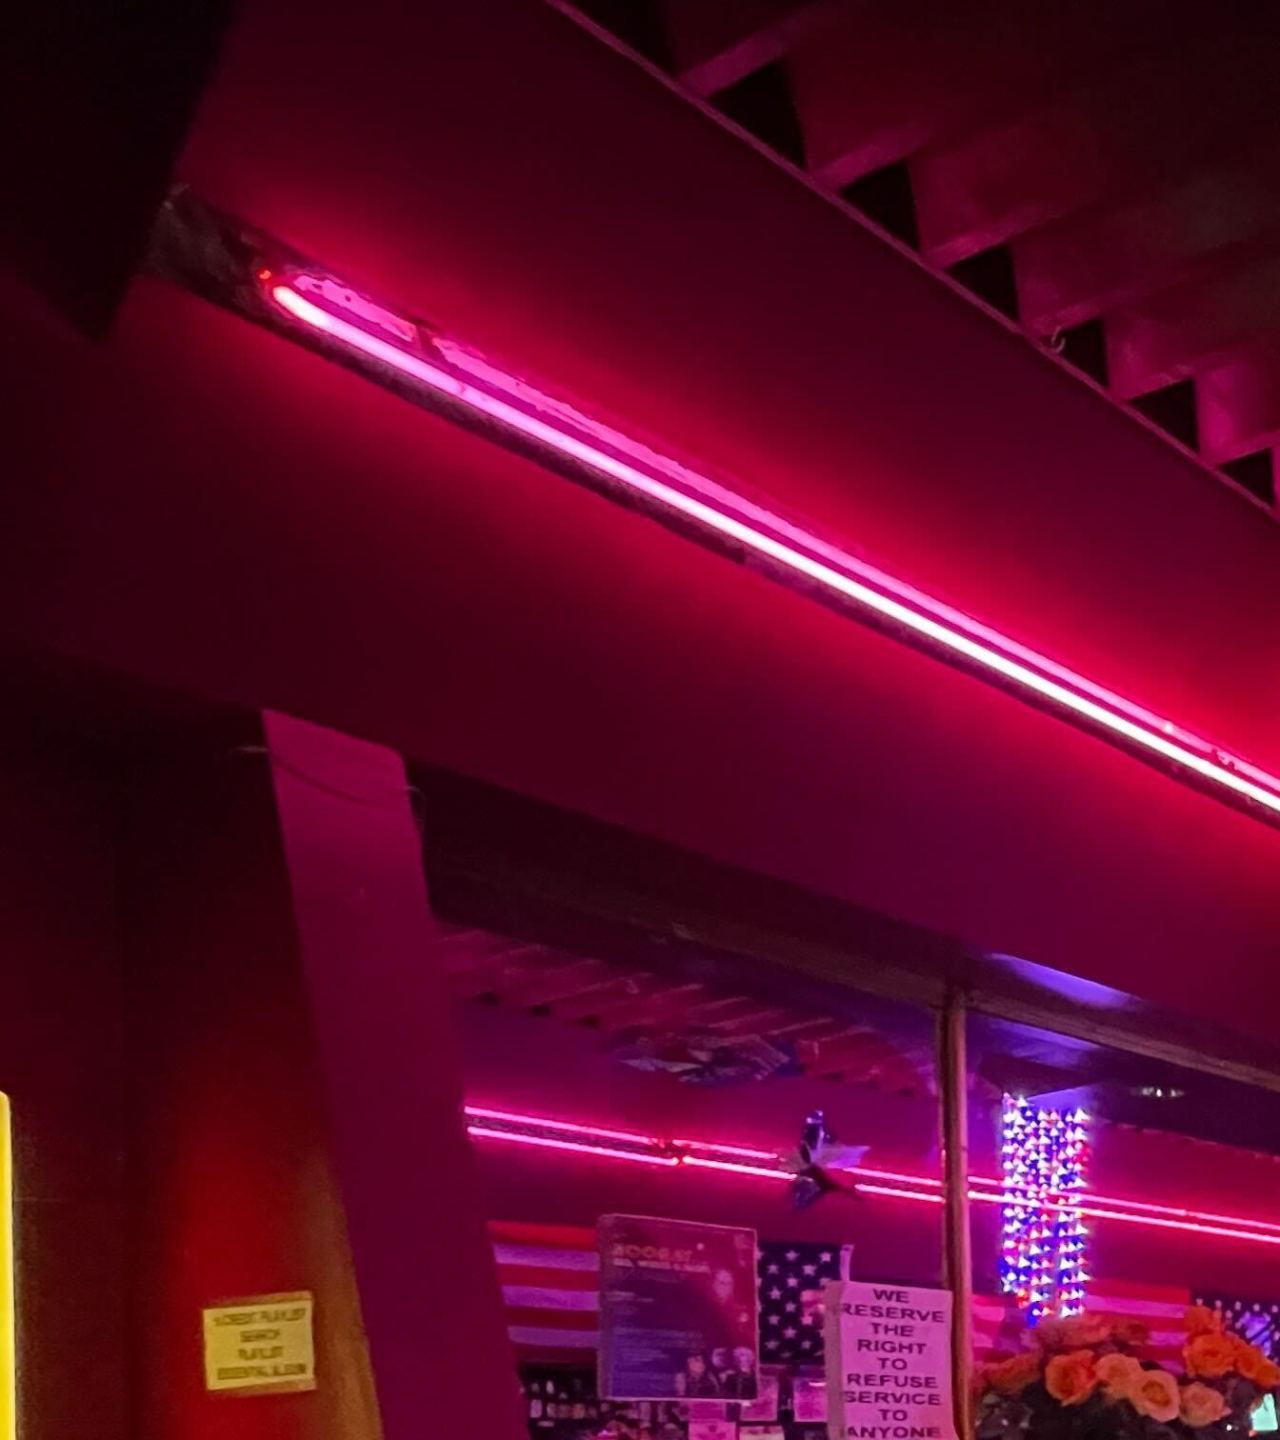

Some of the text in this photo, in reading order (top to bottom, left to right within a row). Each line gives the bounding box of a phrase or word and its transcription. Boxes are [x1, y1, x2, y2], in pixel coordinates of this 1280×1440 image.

[872, 1288, 910, 1304] WE
[841, 1303, 945, 1323] RESERVE
[870, 1322, 915, 1337] THE
[857, 1338, 927, 1355] RIGHT
[877, 1357, 908, 1371] TO
[847, 1373, 939, 1389] REFUSE
[842, 1391, 942, 1406] SERVICE
[877, 1408, 908, 1422] TO
[845, 1426, 941, 1439] ANYONE
